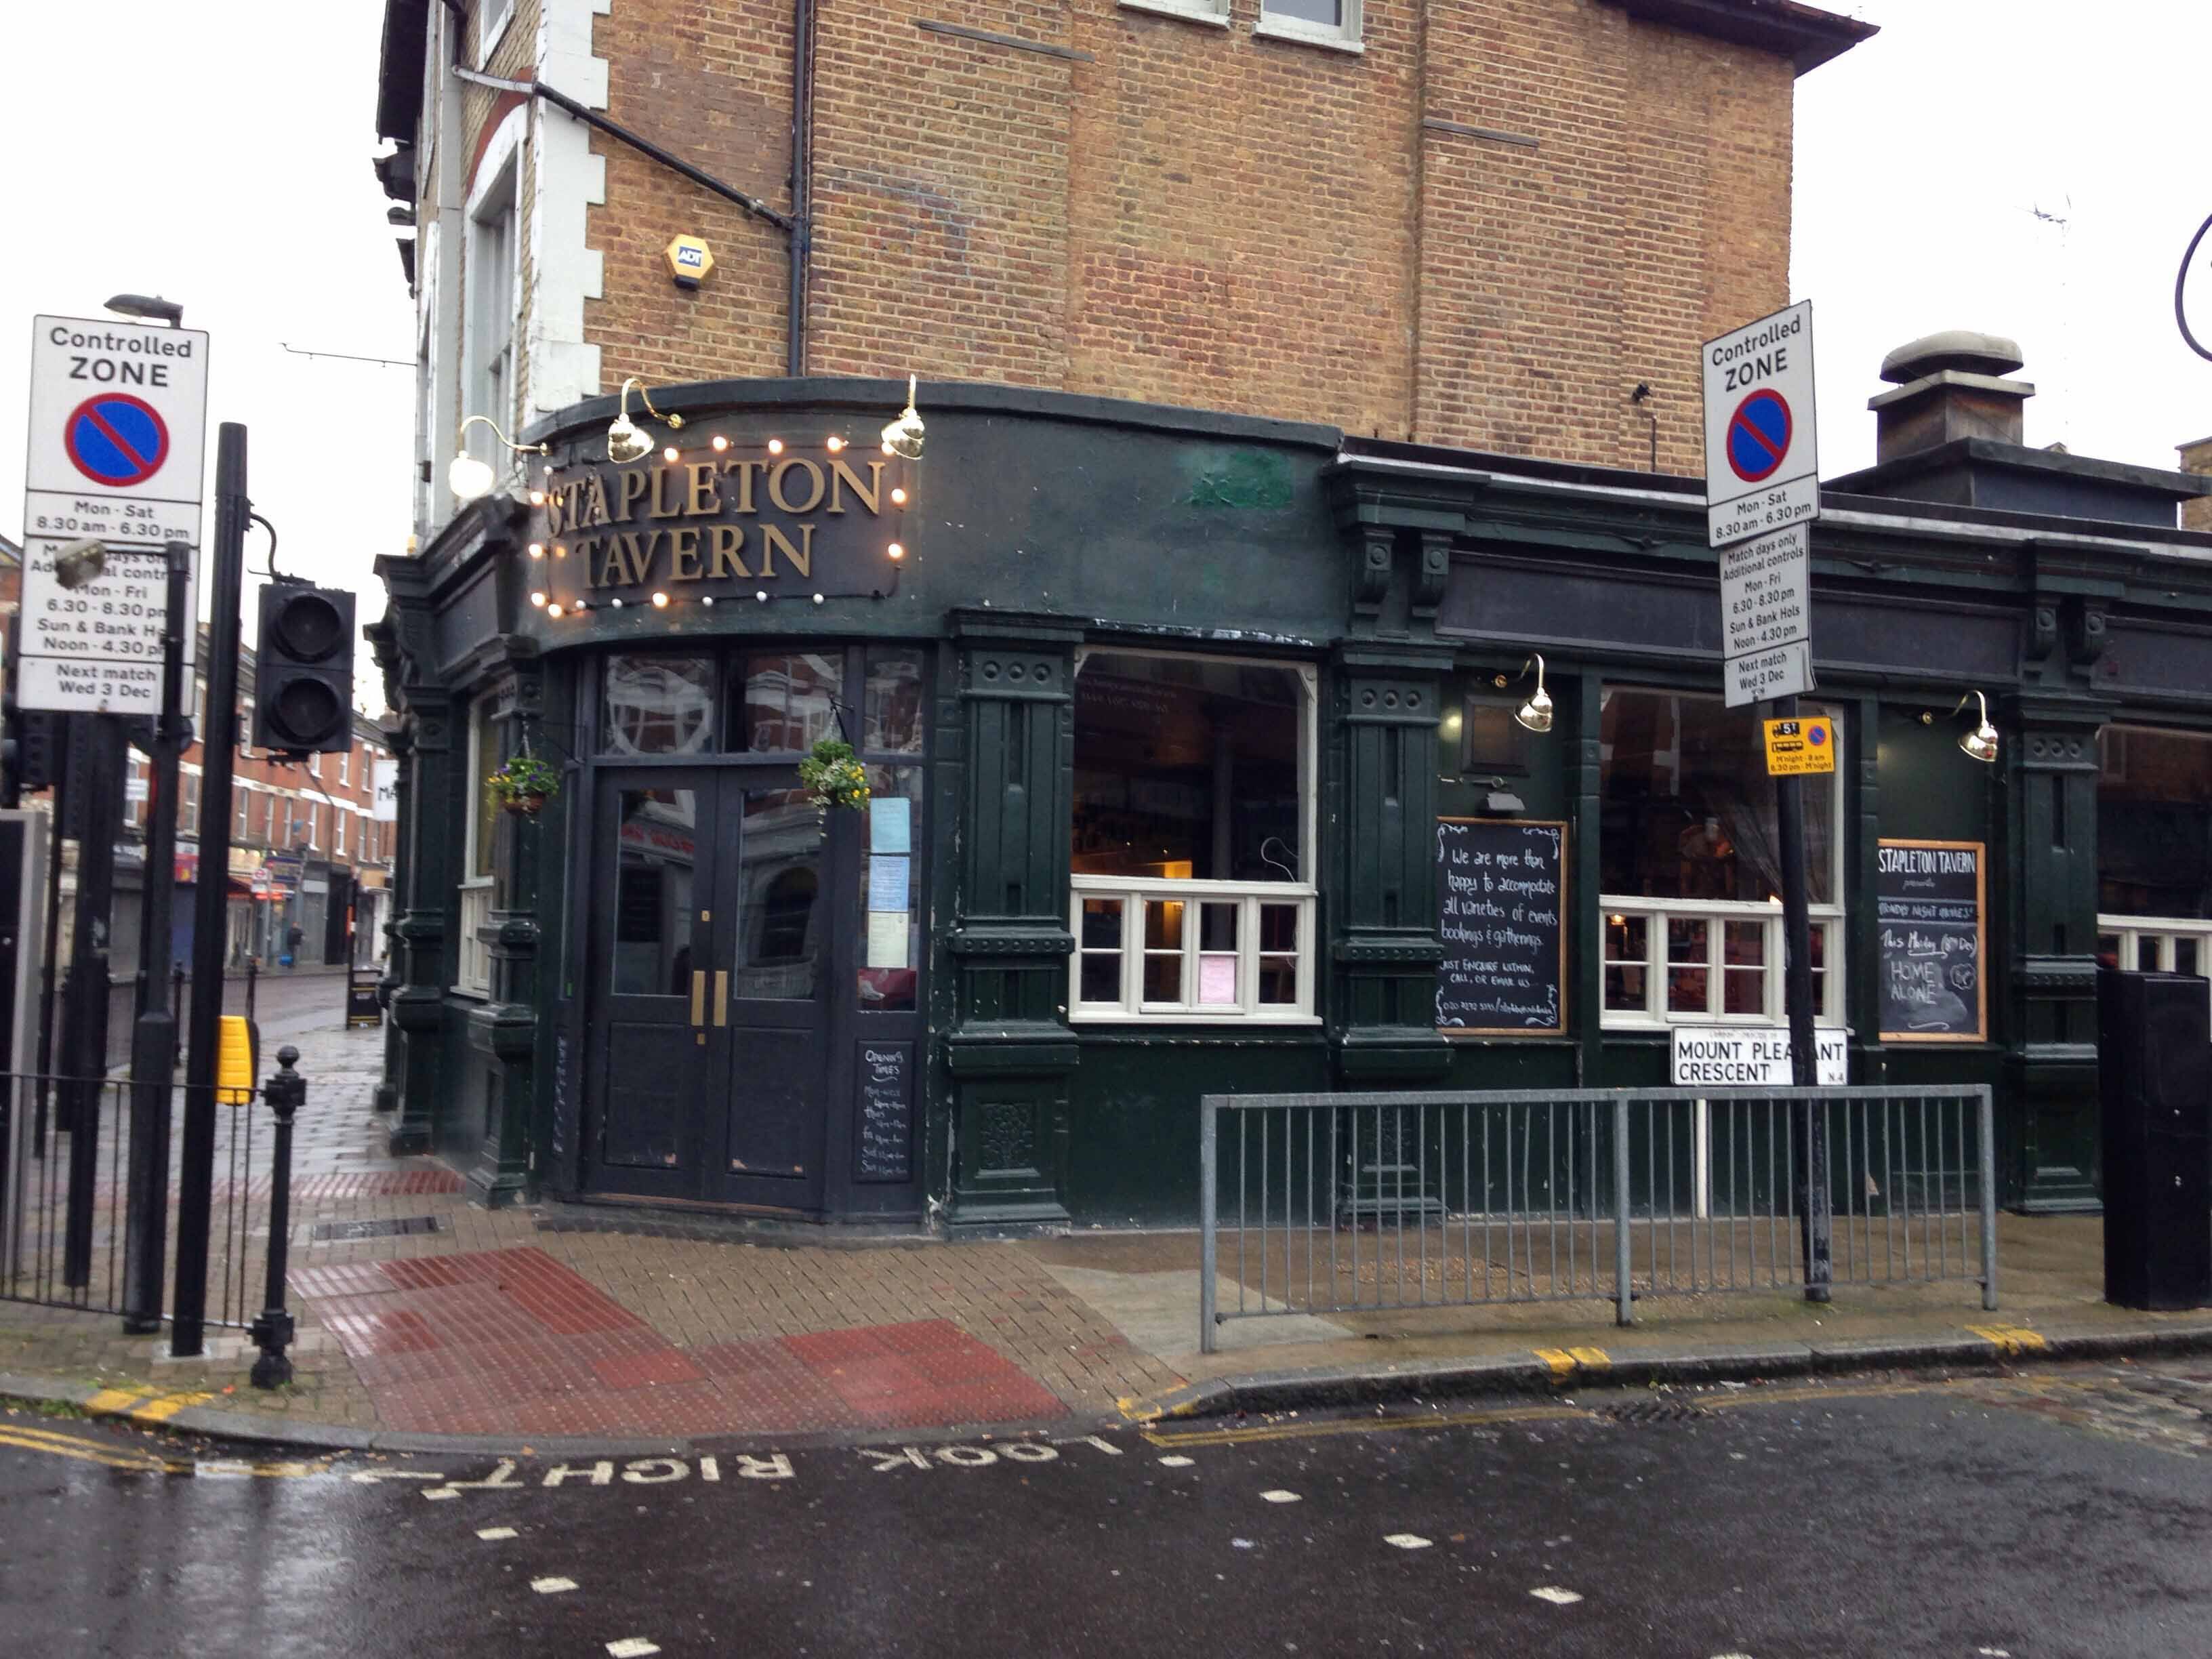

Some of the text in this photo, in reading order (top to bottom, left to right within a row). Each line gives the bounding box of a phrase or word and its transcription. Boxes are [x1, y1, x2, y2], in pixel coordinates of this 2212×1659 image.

[678, 248, 701, 265] ADT
[50, 327, 191, 358] Controlled
[1713, 314, 1800, 366] Controlled
[69, 356, 168, 387] ZONE
[1725, 348, 1788, 392] ZONE
[548, 457, 885, 538] STAPLETON
[1737, 501, 1759, 516] Mon
[1768, 490, 1787, 506] Sat
[75, 501, 110, 514] Mon
[124, 504, 154, 518] Sat
[1716, 522, 1740, 539] 8.30
[1742, 520, 1758, 531] am
[1766, 506, 1792, 524] 6.30
[1794, 502, 1811, 518] pm
[37, 516, 77, 531] 8.30
[81, 522, 106, 532] am
[120, 522, 160, 536] 6.30
[164, 528, 190, 539] pm
[576, 523, 816, 589] TAVERN
[1729, 532, 1797, 565] Match days only
[1723, 546, 1804, 582] Additional controls
[75, 583, 110, 596] Mon
[125, 586, 147, 598] Fri
[1744, 580, 1762, 594] Mon
[1769, 572, 1781, 586] Fri
[1781, 588, 1795, 602] pm
[47, 598, 87, 613] 6.30
[103, 602, 143, 616] 8.30
[38, 618, 70, 632] Sun
[77, 621, 87, 634] &
[94, 622, 136, 636] Bank
[1729, 605, 1800, 634] Sun & Bank Hols
[43, 636, 89, 651] Noon
[102, 640, 144, 654] 4.30
[1734, 634, 1755, 651] Noon
[1761, 626, 1782, 642] 4.30
[1783, 625, 1797, 638] pm
[57, 664, 157, 681] Next match
[1738, 651, 1787, 673] Next match
[59, 680, 150, 698] Wed 3 Dec
[1740, 670, 1784, 690] Wed 3 Dec
[1452, 848, 1469, 864] We
[1474, 851, 1491, 865] are
[1496, 854, 1518, 869] more
[1878, 849, 1975, 874] STAPLETON TAVERN
[1448, 868, 1477, 896] happy
[1483, 871, 1494, 892] to
[1443, 896, 1458, 915] all
[1528, 909, 1557, 926] events
[1880, 928, 1904, 948] This
[1891, 961, 1934, 983] HOME
[1891, 983, 1936, 1004] ALONE
[1678, 1042, 1742, 1061] MOUNT
[1679, 1063, 1771, 1081] CRESCENT
[447, 1434, 1124, 1486] LOOK RIGHT
